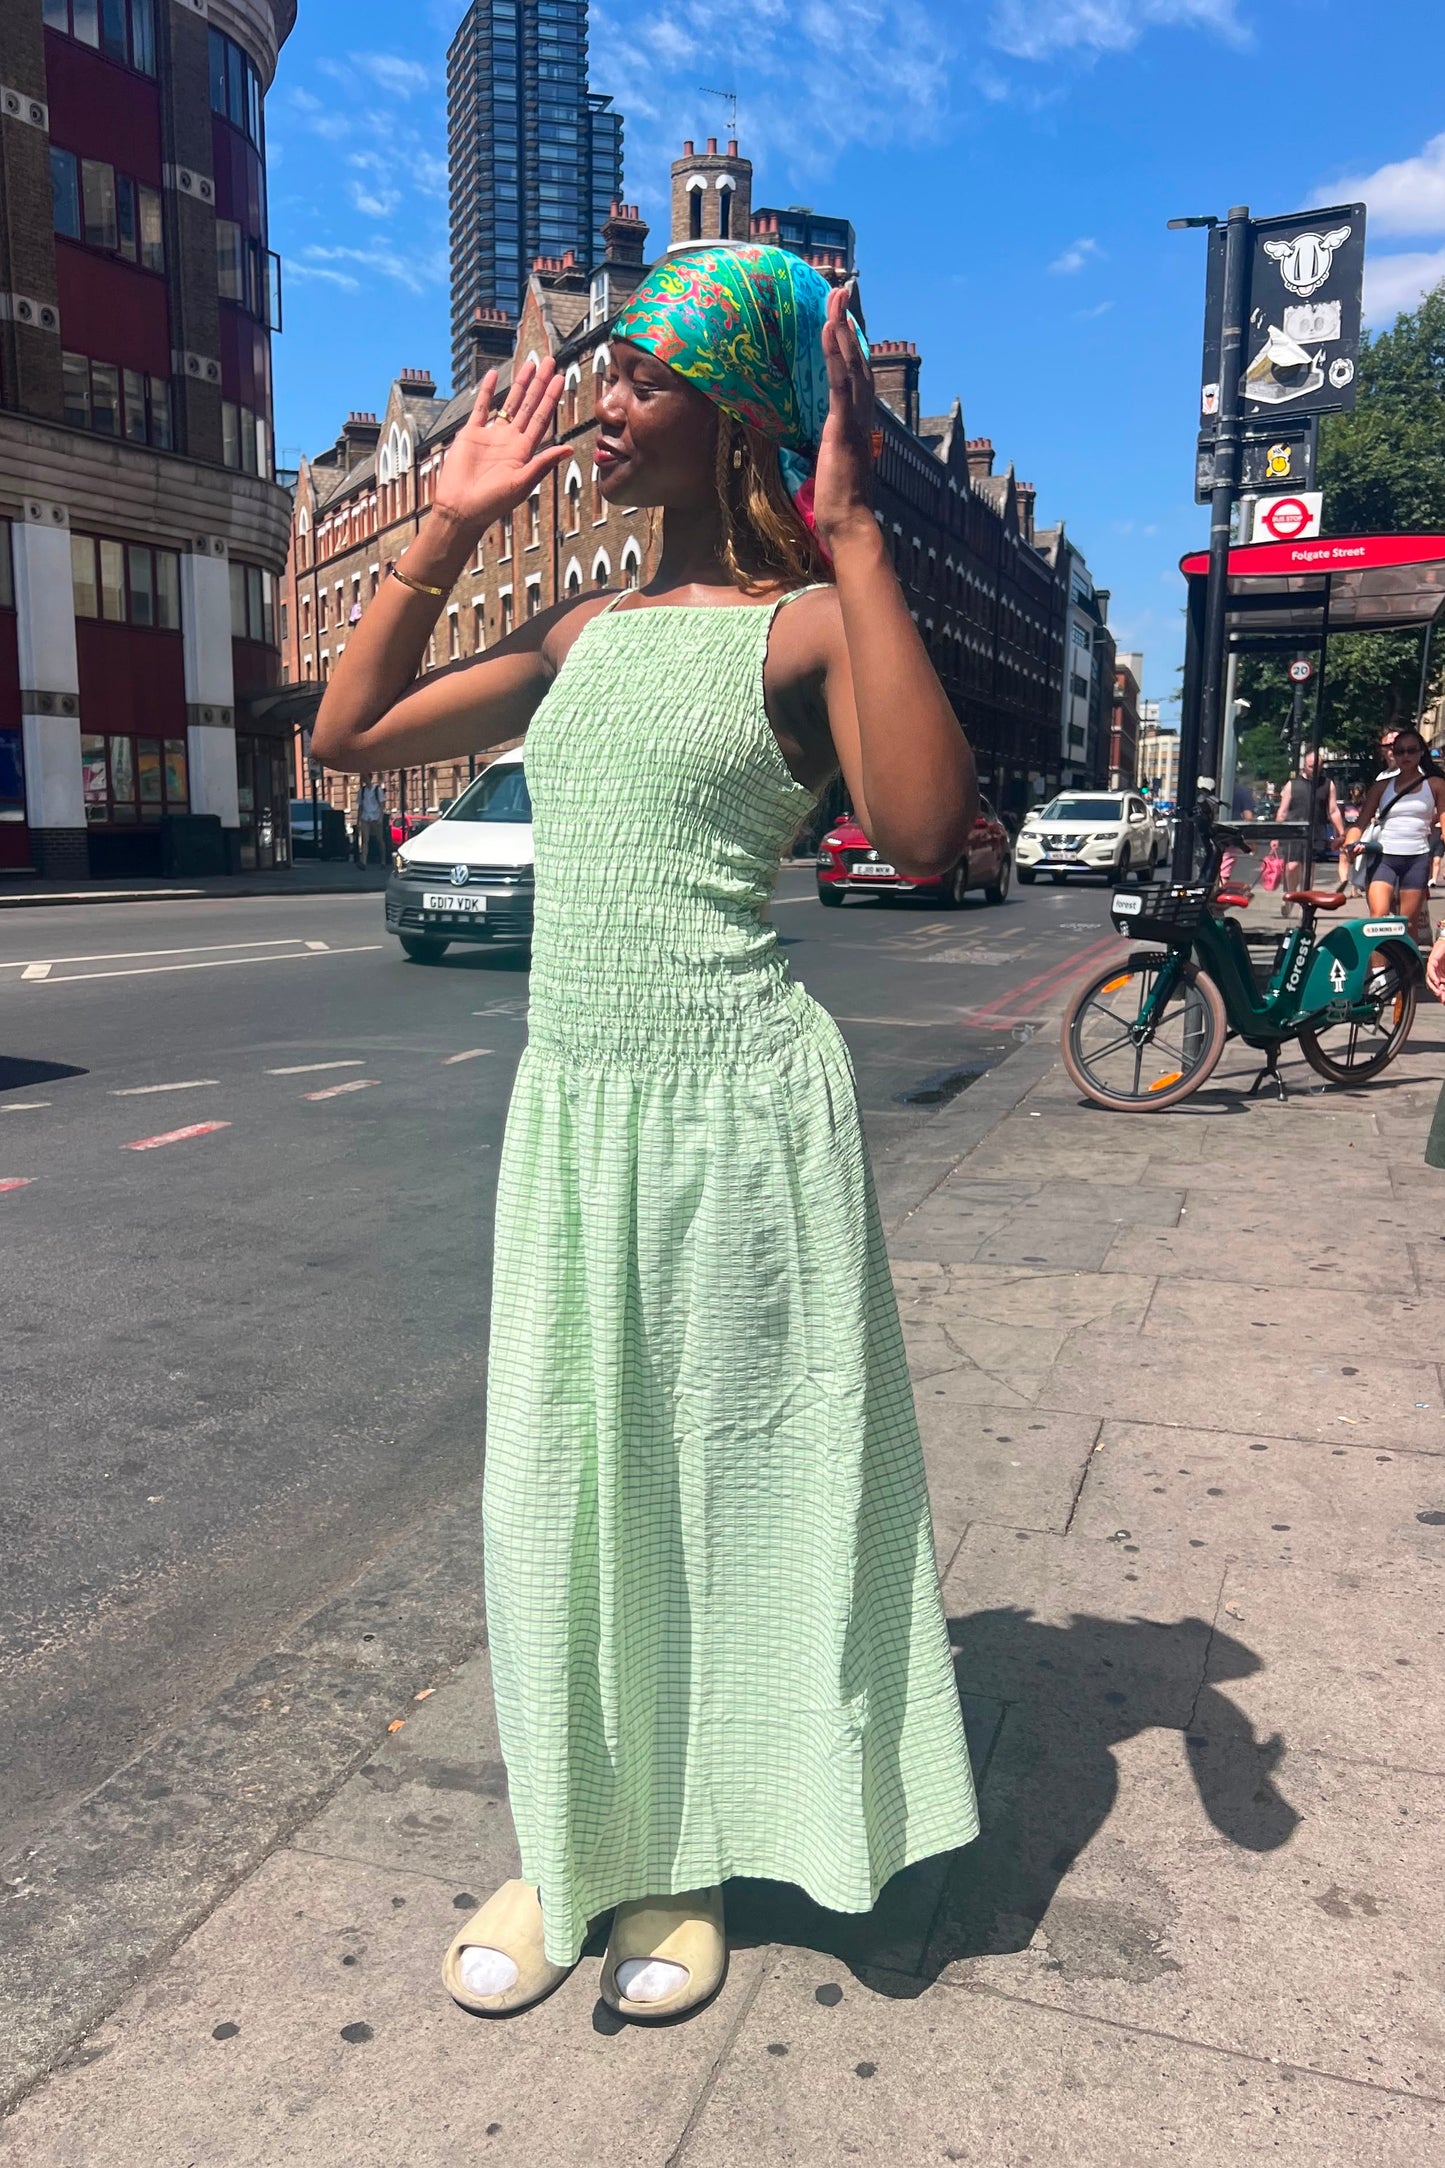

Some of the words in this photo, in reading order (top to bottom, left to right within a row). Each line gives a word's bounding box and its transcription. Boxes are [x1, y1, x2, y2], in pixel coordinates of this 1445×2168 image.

[1271, 515, 1286, 523] BUS
[1287, 514, 1303, 522] STOP
[1291, 549, 1330, 562] Folgate
[1332, 546, 1365, 558] Street
[1293, 666, 1308, 675] 20
[430, 896, 454, 909] GD17
[457, 897, 479, 911] VDK
[1116, 901, 1137, 910] forest
[1286, 937, 1312, 992] forest
